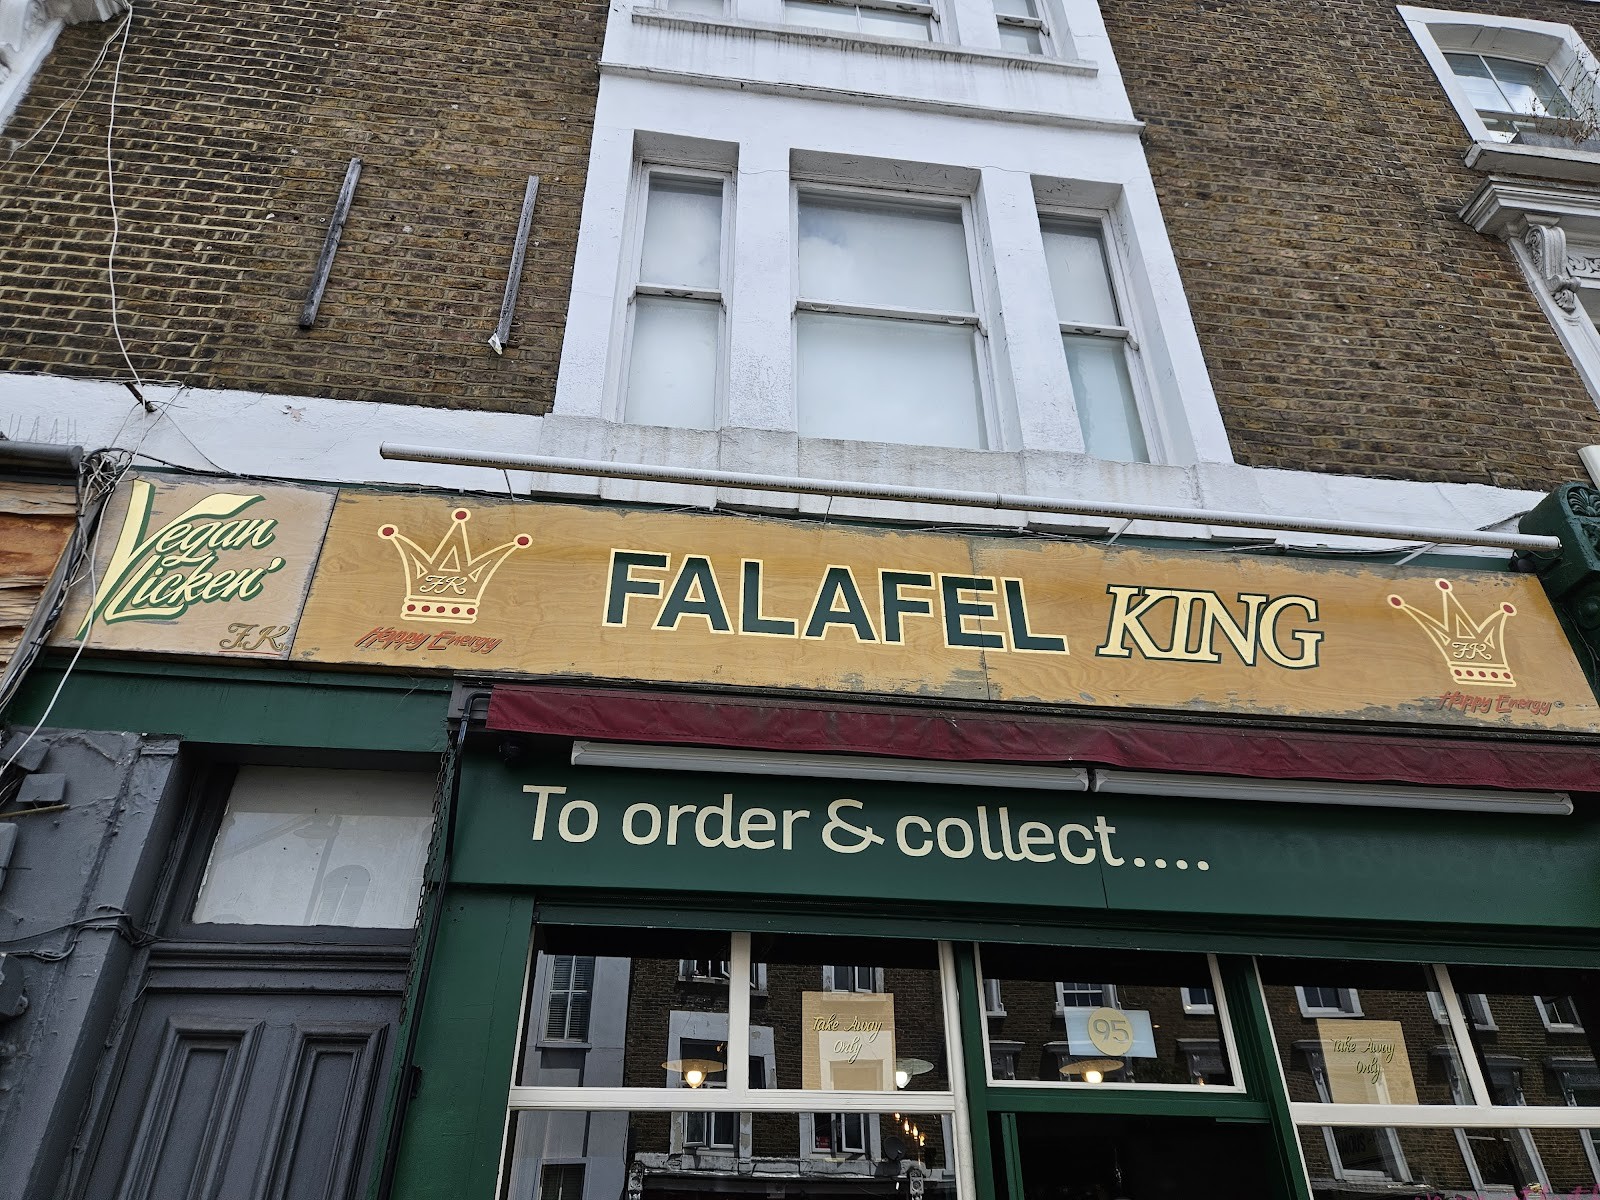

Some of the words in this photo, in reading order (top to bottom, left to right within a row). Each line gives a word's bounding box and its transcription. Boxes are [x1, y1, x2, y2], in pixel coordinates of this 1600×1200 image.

[75, 479, 279, 641] Vegan
[601, 548, 1071, 655] FALAFEL
[1096, 583, 1324, 670] KING
[354, 626, 431, 651] Happy
[427, 630, 503, 655] Energy
[1437, 690, 1493, 714] Happy
[1495, 694, 1552, 716] Energy
[522, 785, 599, 843] To
[621, 793, 811, 851] order
[821, 798, 886, 854] &
[812, 1013, 840, 1032] Take
[843, 1015, 883, 1043] Away
[1092, 1018, 1130, 1044] 95
[833, 1036, 863, 1064] Only
[1330, 1035, 1357, 1053] Take
[1360, 1038, 1396, 1063] Away
[1356, 1057, 1381, 1085] Only
